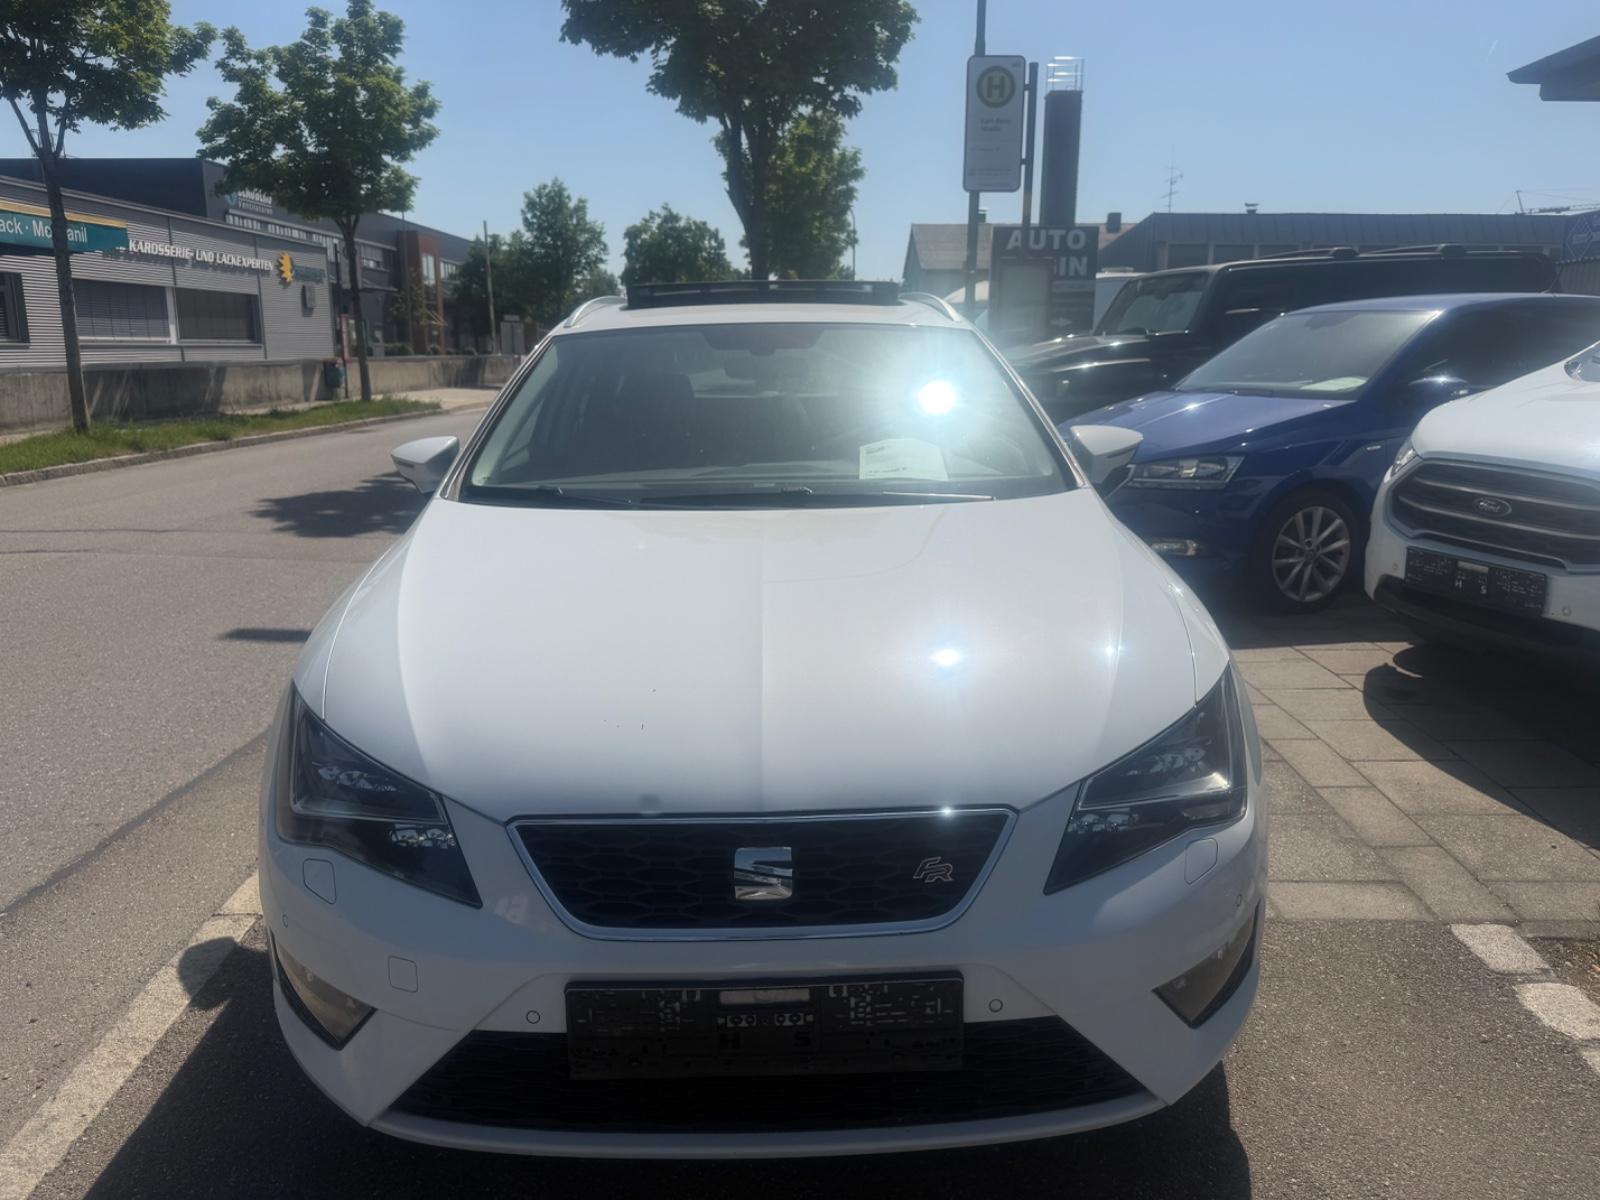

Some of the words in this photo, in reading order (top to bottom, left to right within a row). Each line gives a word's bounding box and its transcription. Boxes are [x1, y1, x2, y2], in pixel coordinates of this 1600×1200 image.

[986, 75, 1005, 99] H
[1006, 229, 1087, 250] AUTO
[195, 249, 214, 263] UND
[216, 252, 274, 271] LACKEXPERTEN
[1054, 256, 1088, 277] IN
